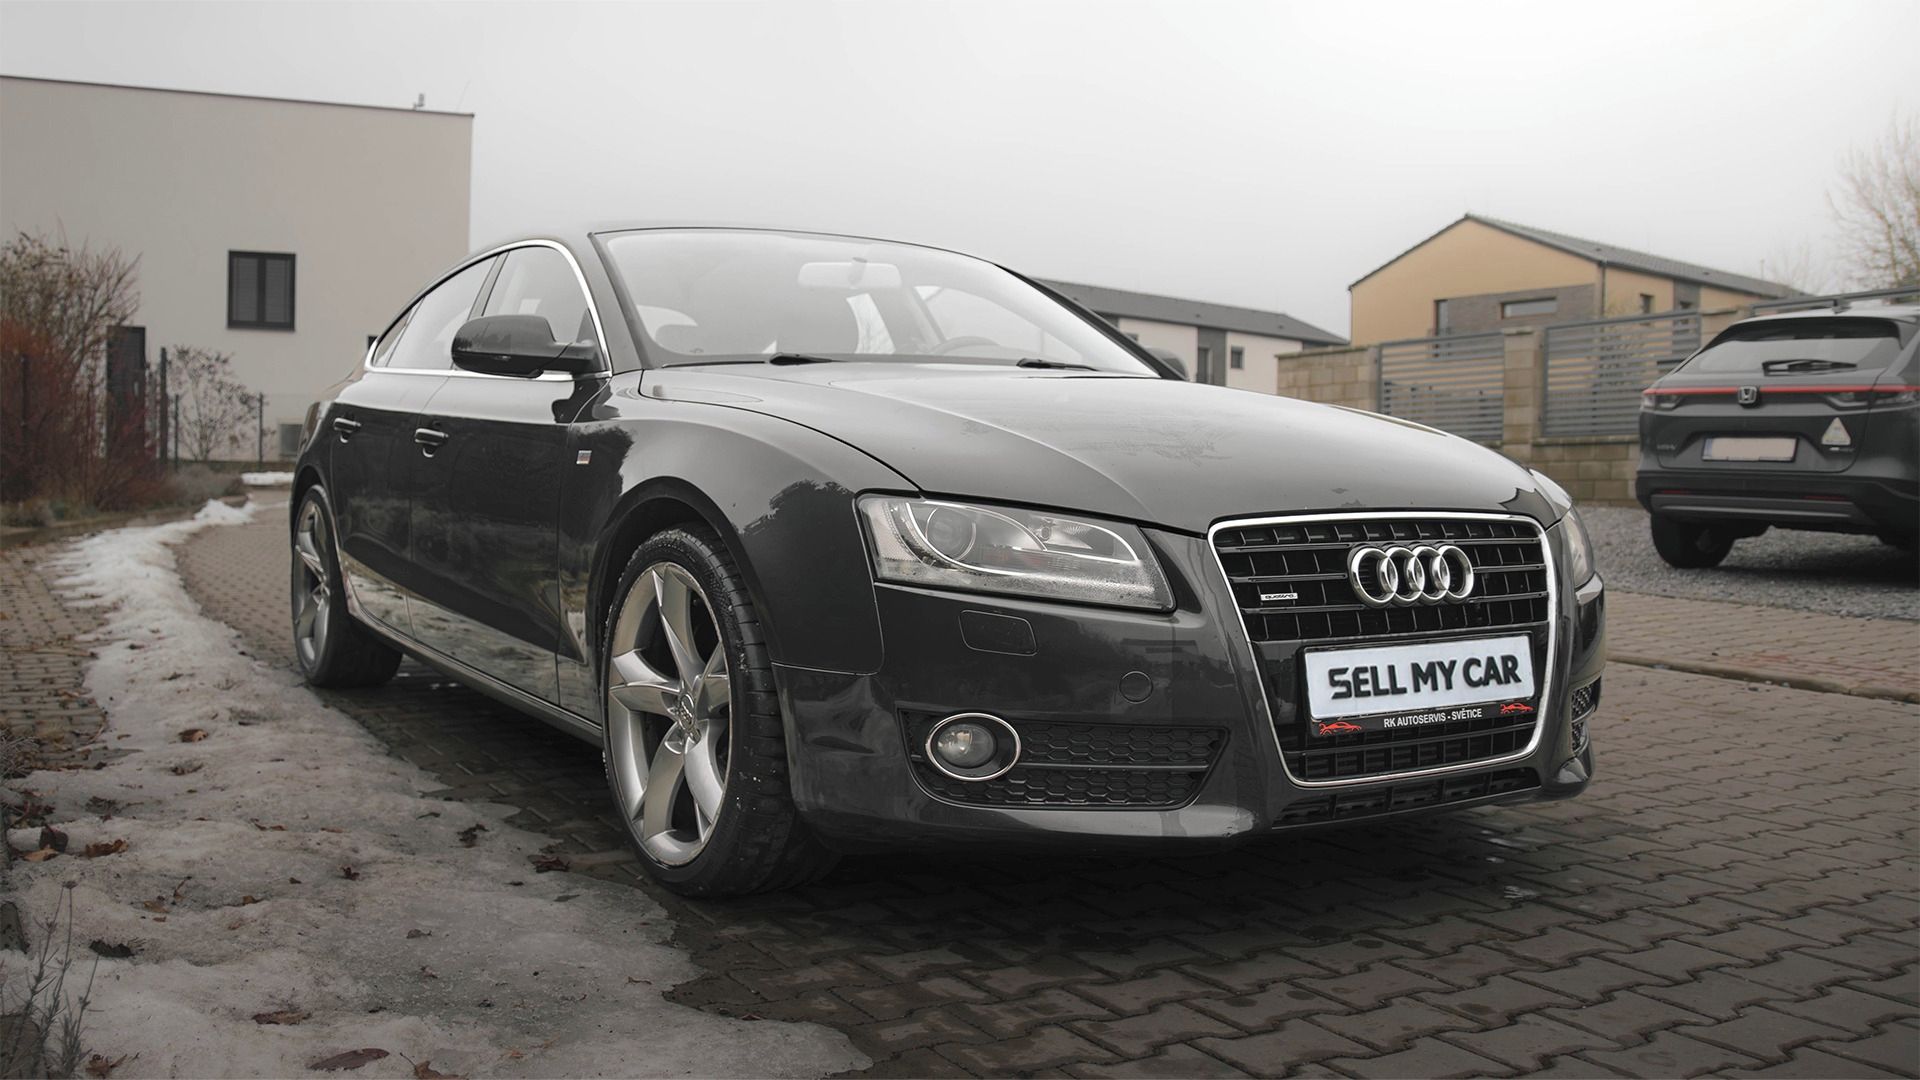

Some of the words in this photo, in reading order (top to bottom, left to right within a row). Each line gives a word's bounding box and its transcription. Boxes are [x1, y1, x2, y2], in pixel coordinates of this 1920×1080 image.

[1328, 664, 1407, 700] SELL
[1411, 660, 1457, 692] MY
[1462, 654, 1522, 688] CAR
[1383, 717, 1397, 728] RK
[1397, 712, 1446, 726] AUTOSERVIS
[1451, 708, 1483, 720] SVĚTICE
